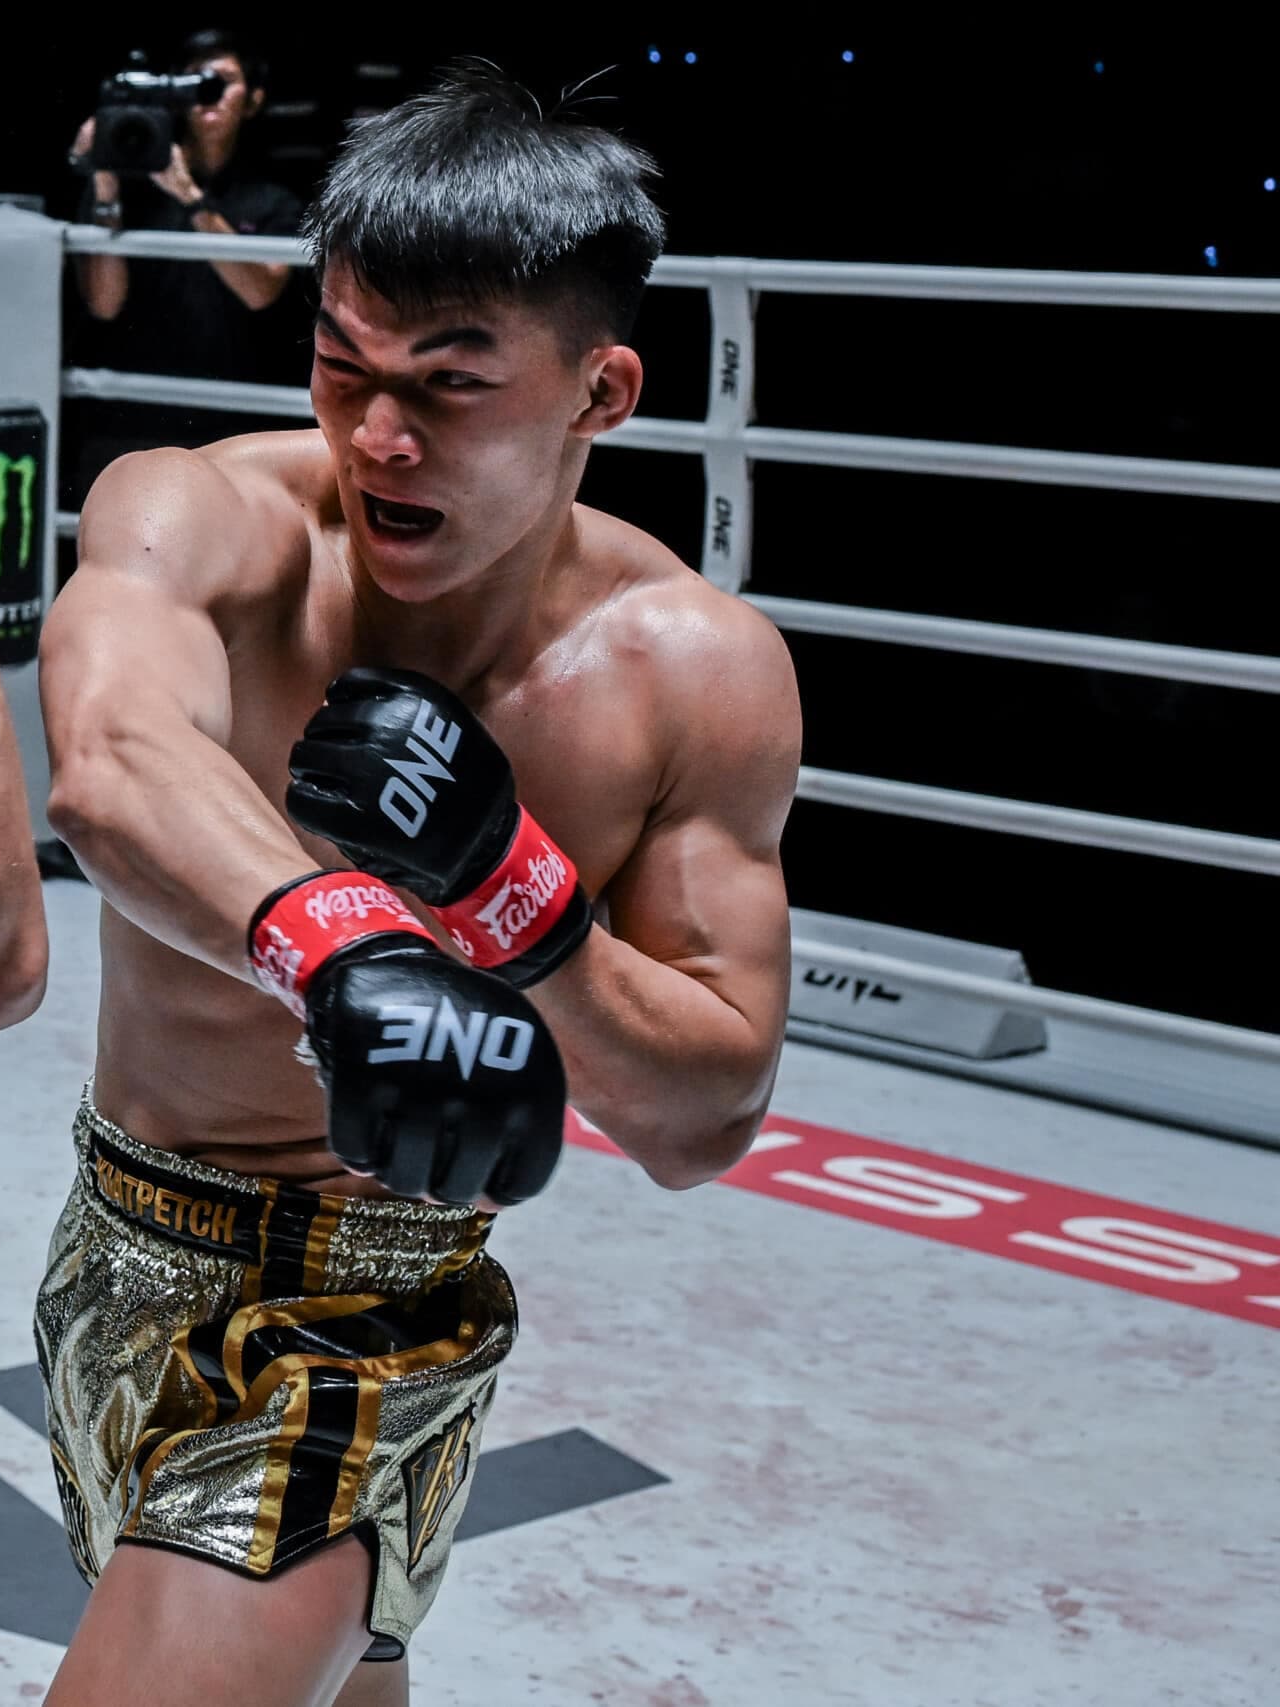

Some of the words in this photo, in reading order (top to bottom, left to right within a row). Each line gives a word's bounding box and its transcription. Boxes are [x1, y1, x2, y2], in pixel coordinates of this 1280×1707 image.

[720, 339, 740, 399] ONE
[713, 496, 732, 556] ONE
[379, 699, 463, 839] ONE
[475, 840, 566, 950] Fairtex
[367, 996, 535, 1081] ONE
[96, 1155, 238, 1244] KIATPETCH
